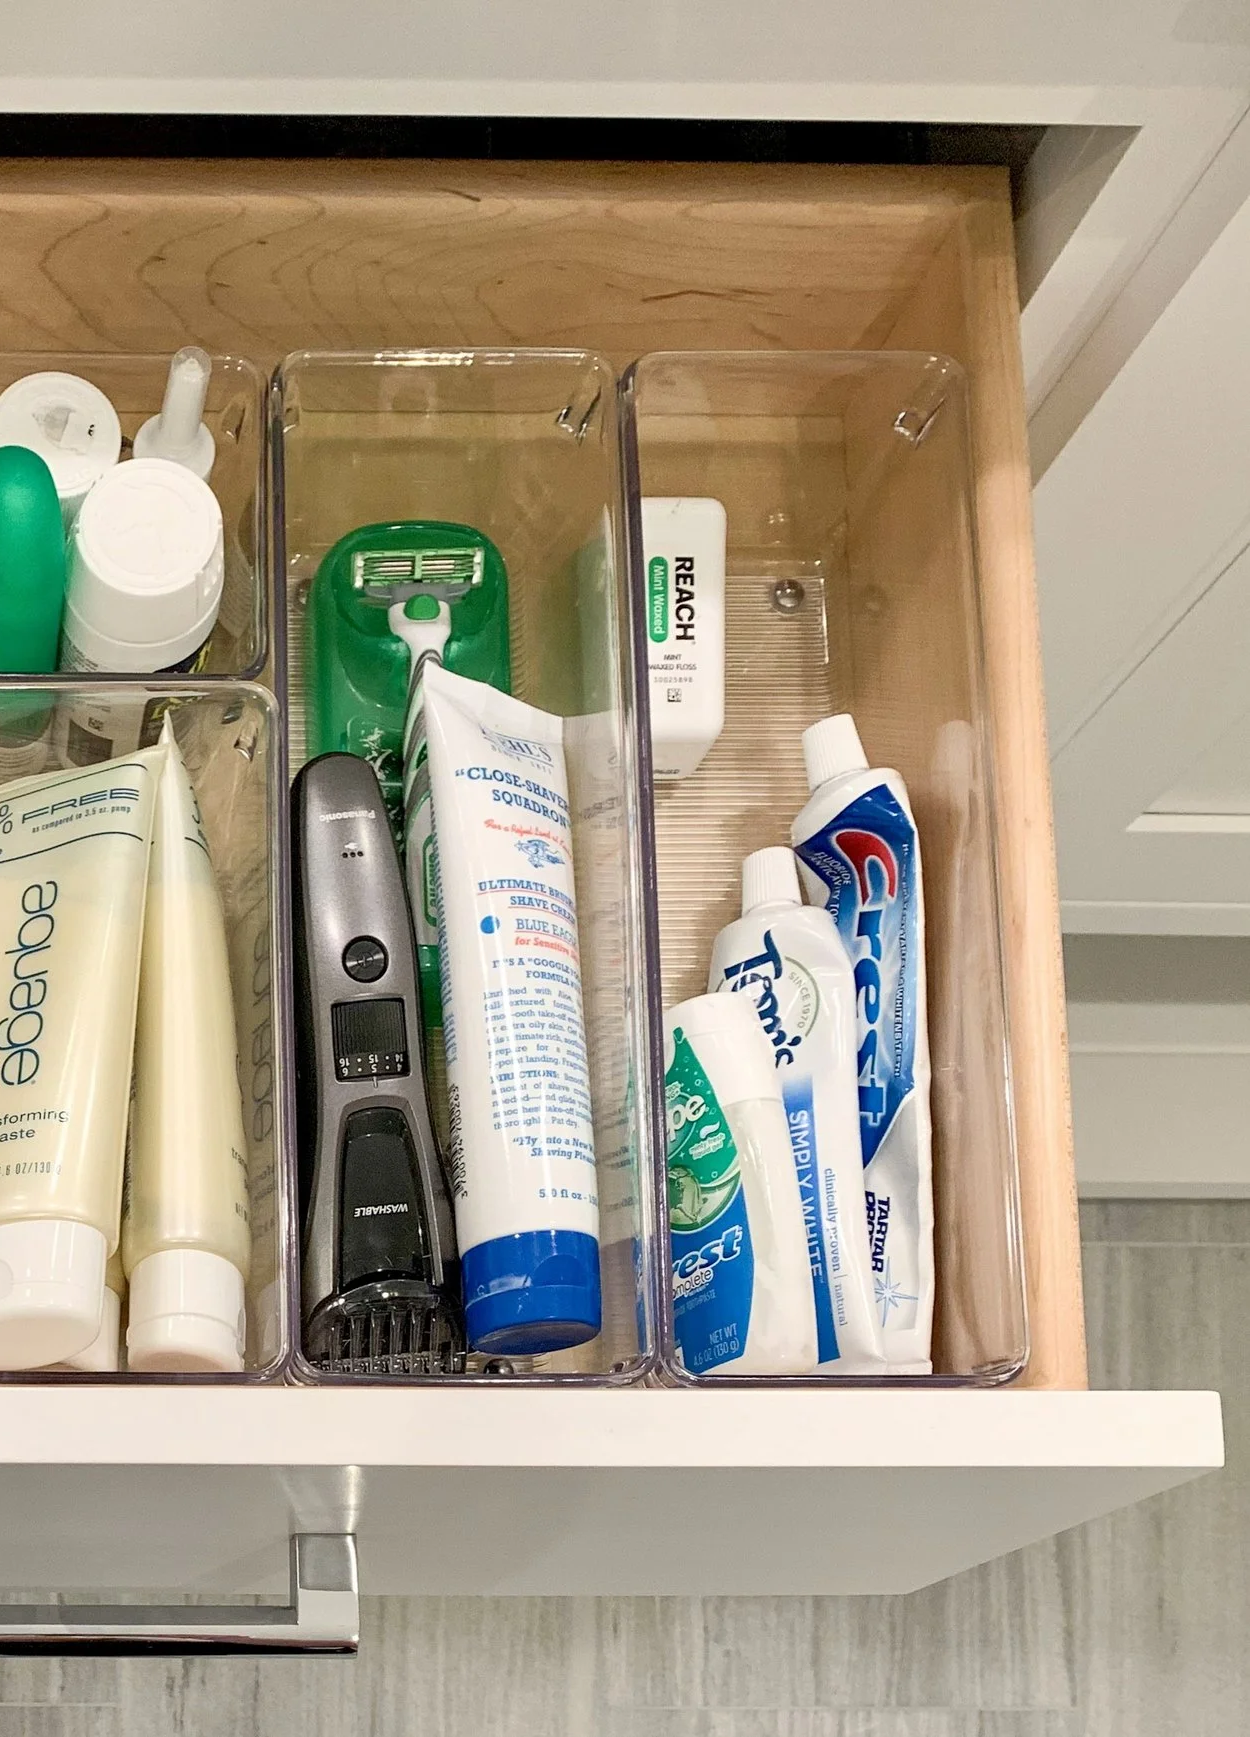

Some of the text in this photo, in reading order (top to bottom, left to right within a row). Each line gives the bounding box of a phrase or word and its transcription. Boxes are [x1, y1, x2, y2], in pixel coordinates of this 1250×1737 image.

[653, 564, 665, 635] Mint Waxed
[675, 556, 695, 641] REACH
[22, 788, 140, 824] FREE
[32, 825, 40, 833] as
[41, 814, 74, 831] compared
[75, 812, 83, 820] to
[84, 806, 97, 818] 3.5
[111, 805, 131, 814] pump
[319, 808, 376, 823] Panasonic
[814, 850, 851, 885] FLUORIDE
[478, 879, 548, 894] ULTIMATE
[808, 855, 842, 903] ANTICAVITY
[510, 896, 549, 910] SHAVE
[515, 918, 550, 933] BLUE
[515, 936, 531, 946] for
[517, 957, 526, 966] A
[526, 970, 570, 986] FORMULA
[834, 828, 898, 1127] Crest
[535, 987, 552, 996] with
[789, 971, 812, 1030] SINCE 1970
[538, 1009, 566, 1021] take-off
[529, 1020, 545, 1030] oily
[893, 988, 904, 1077] WHITENS TEETH
[536, 1043, 550, 1051] for
[339, 1053, 404, 1068] 14 15 16
[342, 1063, 403, 1077] 4 5 6
[548, 1083, 570, 1092] shave
[15, 1161, 51, 1175] OZ/130
[571, 1192, 582, 1200] oz
[789, 1109, 824, 1277] SIMPLY WHITE
[354, 1203, 409, 1218] WASHABLE
[871, 1196, 890, 1273] TARTAR
[672, 1224, 743, 1279] rest
[824, 1167, 848, 1326] clinically proven natural
[672, 1269, 713, 1299] omplete
[709, 1322, 738, 1345] NET WT
